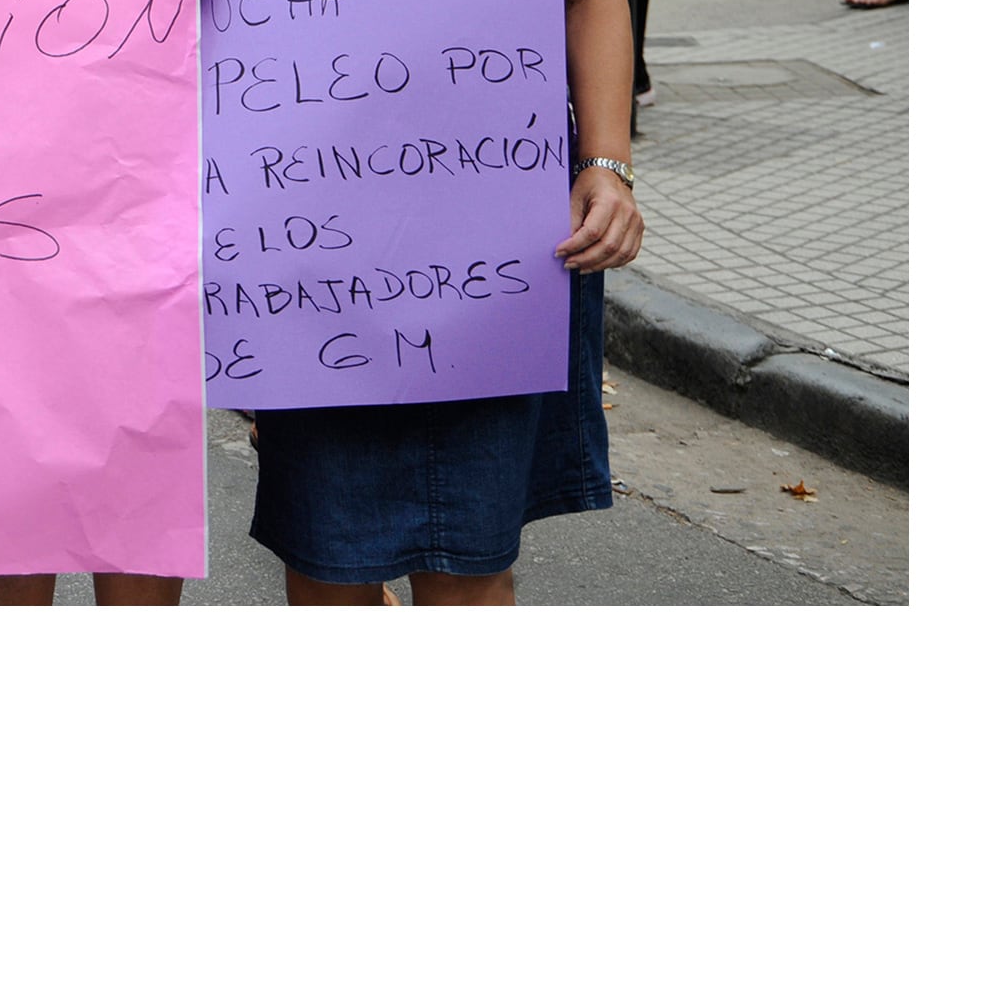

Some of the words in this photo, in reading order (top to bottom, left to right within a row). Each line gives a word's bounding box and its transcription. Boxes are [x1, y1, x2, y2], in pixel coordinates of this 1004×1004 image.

[207, 53, 410, 115] PELEO
[441, 46, 548, 85] POR
[205, 157, 229, 195] A
[250, 112, 566, 190] REINCORACIÓN
[213, 227, 240, 262] E
[258, 214, 354, 253] LOS
[202, 259, 530, 318] RABAJADORES
